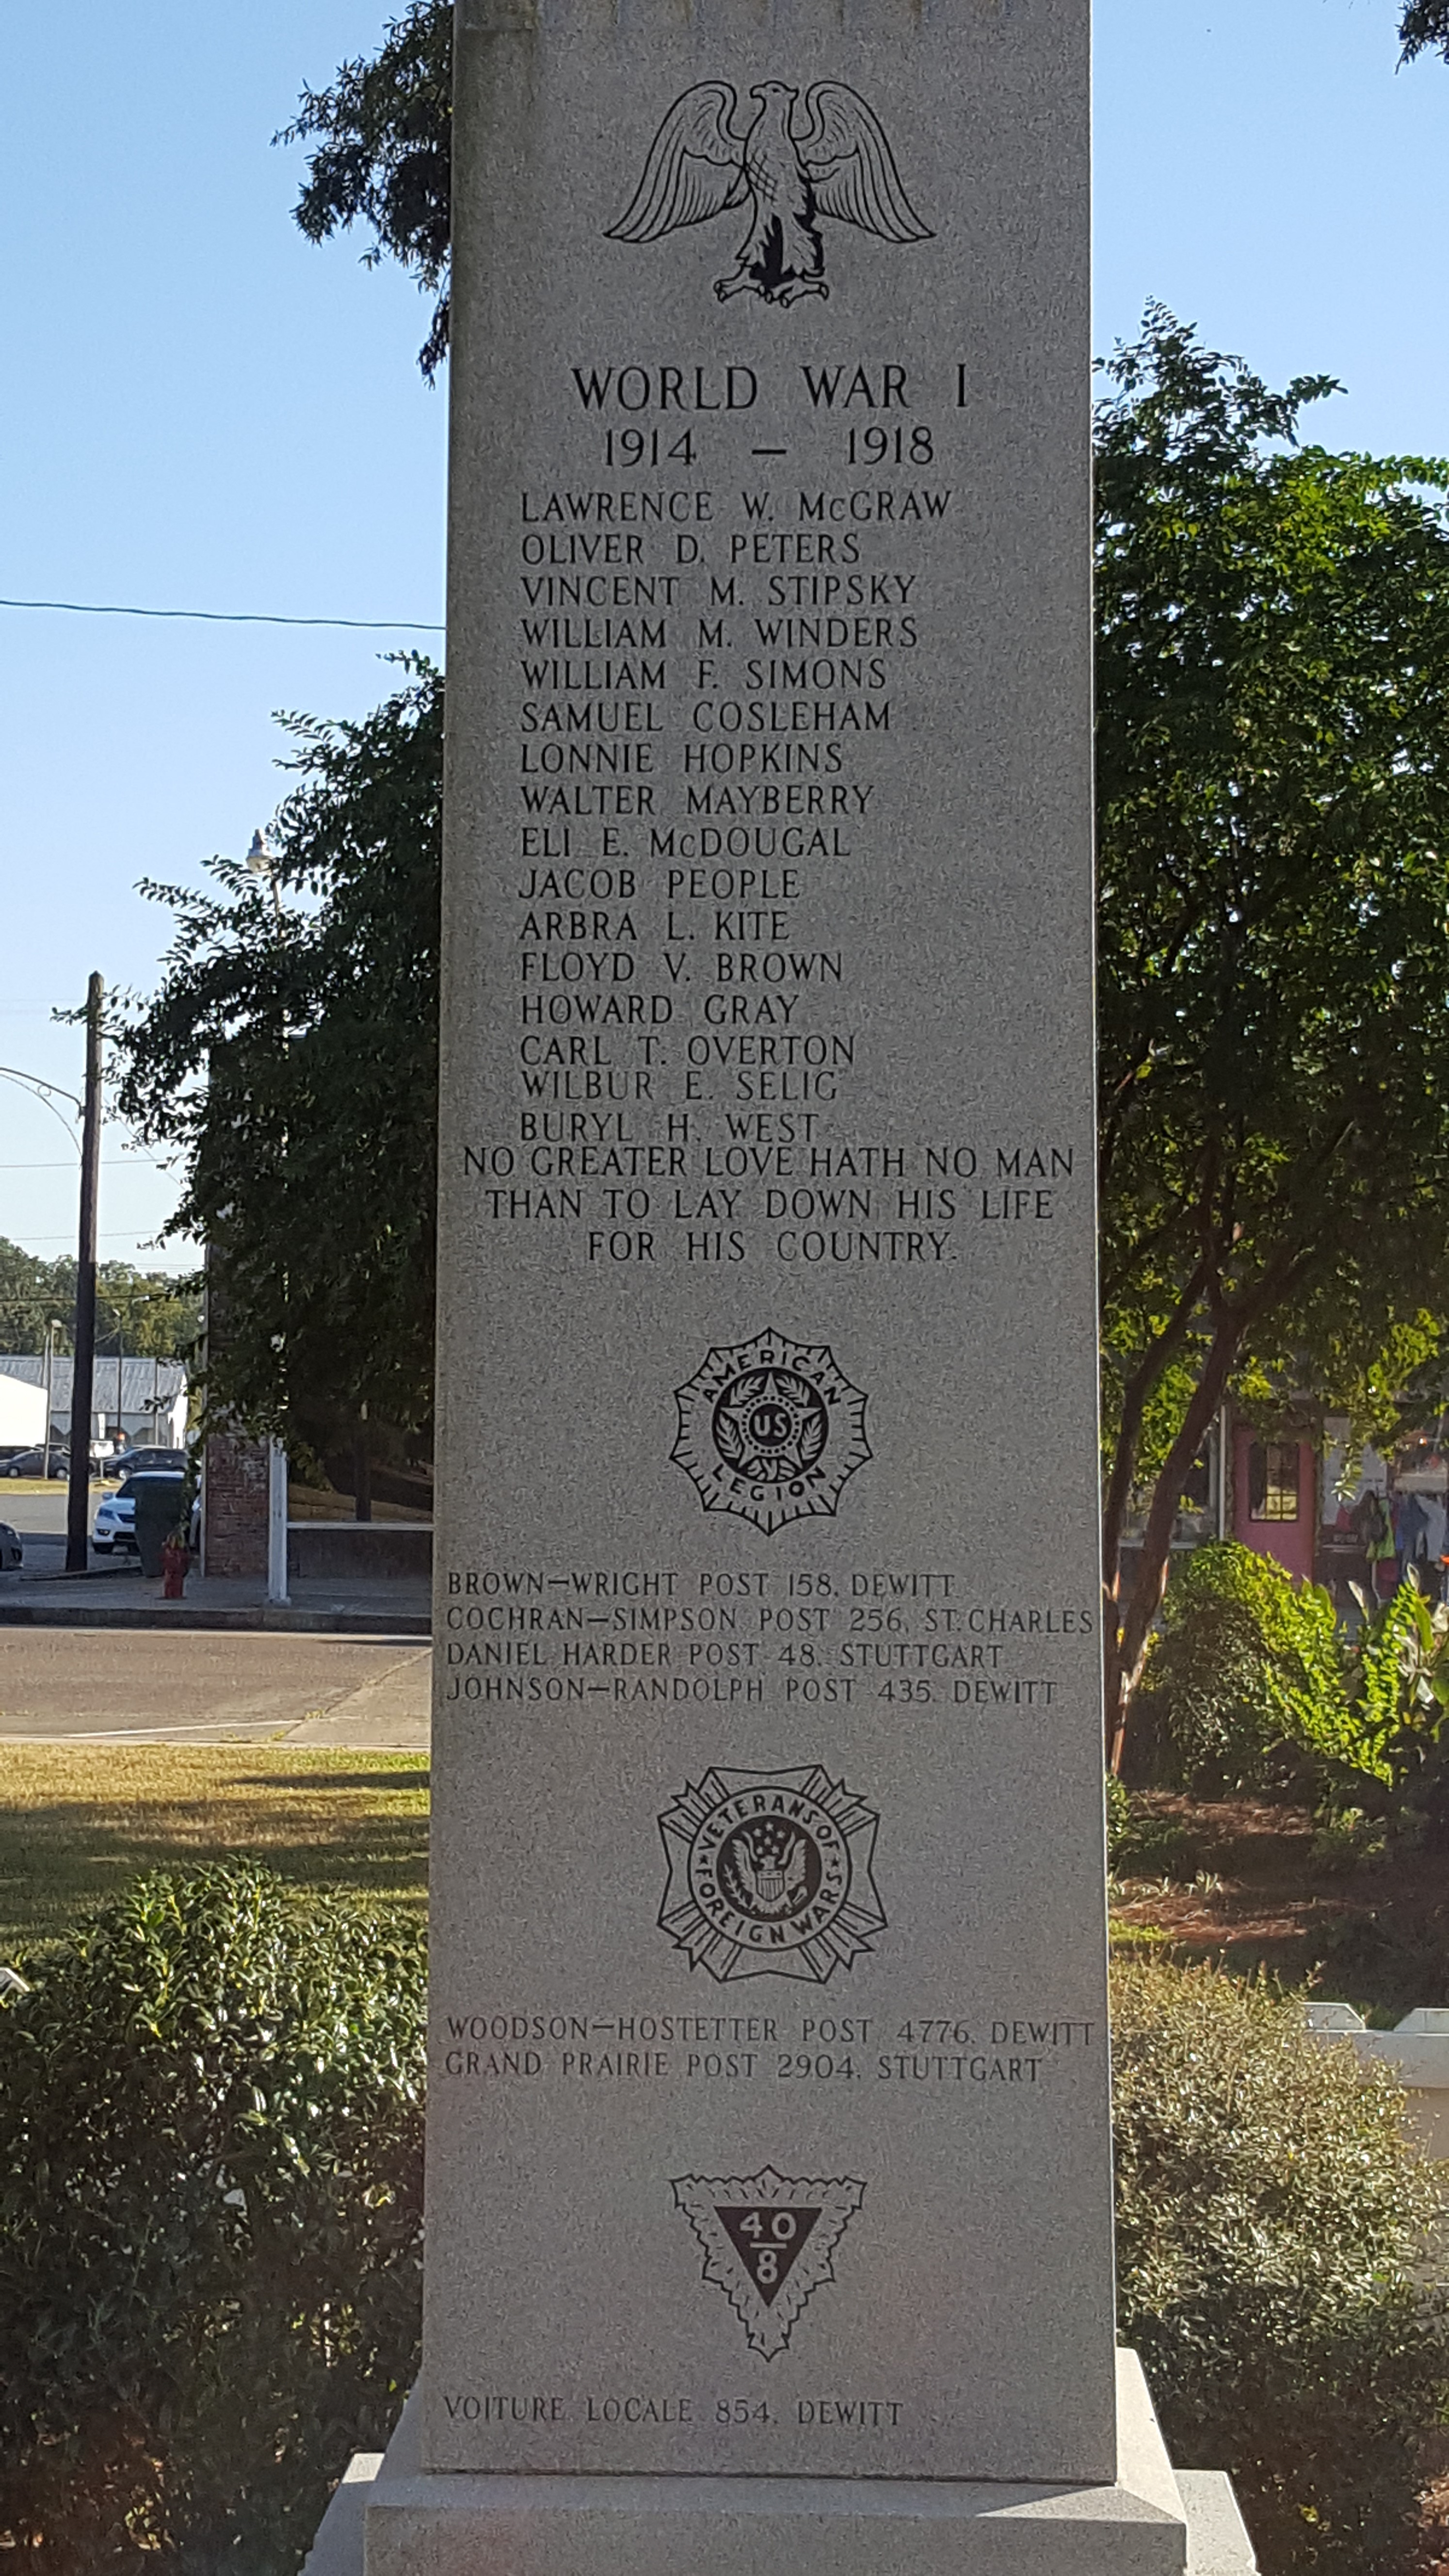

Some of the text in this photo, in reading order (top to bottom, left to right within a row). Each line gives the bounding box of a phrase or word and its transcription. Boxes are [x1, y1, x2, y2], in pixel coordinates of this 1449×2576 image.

[572, 364, 966, 410] WORLD WAR I
[607, 429, 696, 467] 1914
[849, 426, 933, 465] 1918
[522, 490, 951, 522] LAWRENCE W. McGRAW
[522, 533, 859, 564] OLIVER D. PETERS
[521, 575, 915, 606] VINCENT M. STIPSKY
[521, 617, 917, 648] WILLIAM M. WINDERS
[521, 659, 885, 689] WILLIAM F. SIMONS
[522, 701, 889, 732] SAMUEL COSLEHAM
[522, 743, 841, 773] LONNIE HOPKINS
[521, 785, 873, 815] WALTER MAYBERRY
[523, 827, 850, 857] ELI E. McDOUGAL
[519, 869, 799, 899] JACOB PEOPLE
[519, 911, 789, 940] ARBRA L. KITE
[522, 952, 841, 982] FLOYD V. BROWN
[523, 995, 798, 1024] HOWARD GRAY
[521, 1036, 853, 1065] CARL T. OVERTON
[521, 1071, 836, 1100] WILBUR E. SELIG
[522, 1112, 819, 1143] BURYL H. WEST
[465, 1146, 1072, 1177] NO GREATER LOVE HATH NO MAN
[485, 1189, 1052, 1219] THAN TO LAY DOWN HIS LIFE
[589, 1231, 958, 1261] FOR HIS COUNTRY.
[703, 1350, 842, 1405] AMERICAN
[754, 1413, 788, 1437] US
[712, 1463, 826, 1501] LEGION
[701, 1574, 768, 1596] POST
[853, 1574, 954, 1597] DEWITT
[760, 1608, 829, 1631] POST
[925, 1609, 961, 1631] ST.
[969, 1609, 1092, 1633] CHARLES
[448, 1642, 546, 1665] DANIEL
[564, 1643, 670, 1665] HARDER
[690, 1643, 759, 1665] POST
[840, 1643, 1003, 1668] STUTTGART
[787, 1677, 856, 1702] POST
[955, 1681, 1057, 1704] DEWITT
[697, 1794, 840, 1851] VETERANS OF
[696, 1868, 843, 1944] FOREIGN WARS
[803, 2018, 872, 2043] POST
[992, 2021, 1095, 2045] DEWITT
[446, 2051, 541, 2075] GRAND
[563, 2052, 667, 2076] PRAIRIE
[688, 2054, 757, 2077] POST
[879, 2055, 1042, 2082] STUTTGART
[740, 2212, 796, 2240] 40
[757, 2250, 777, 2284] 8
[444, 2396, 563, 2421] VOITURE
[587, 2397, 692, 2422] LOCALE
[799, 2401, 902, 2427] DEWITT
